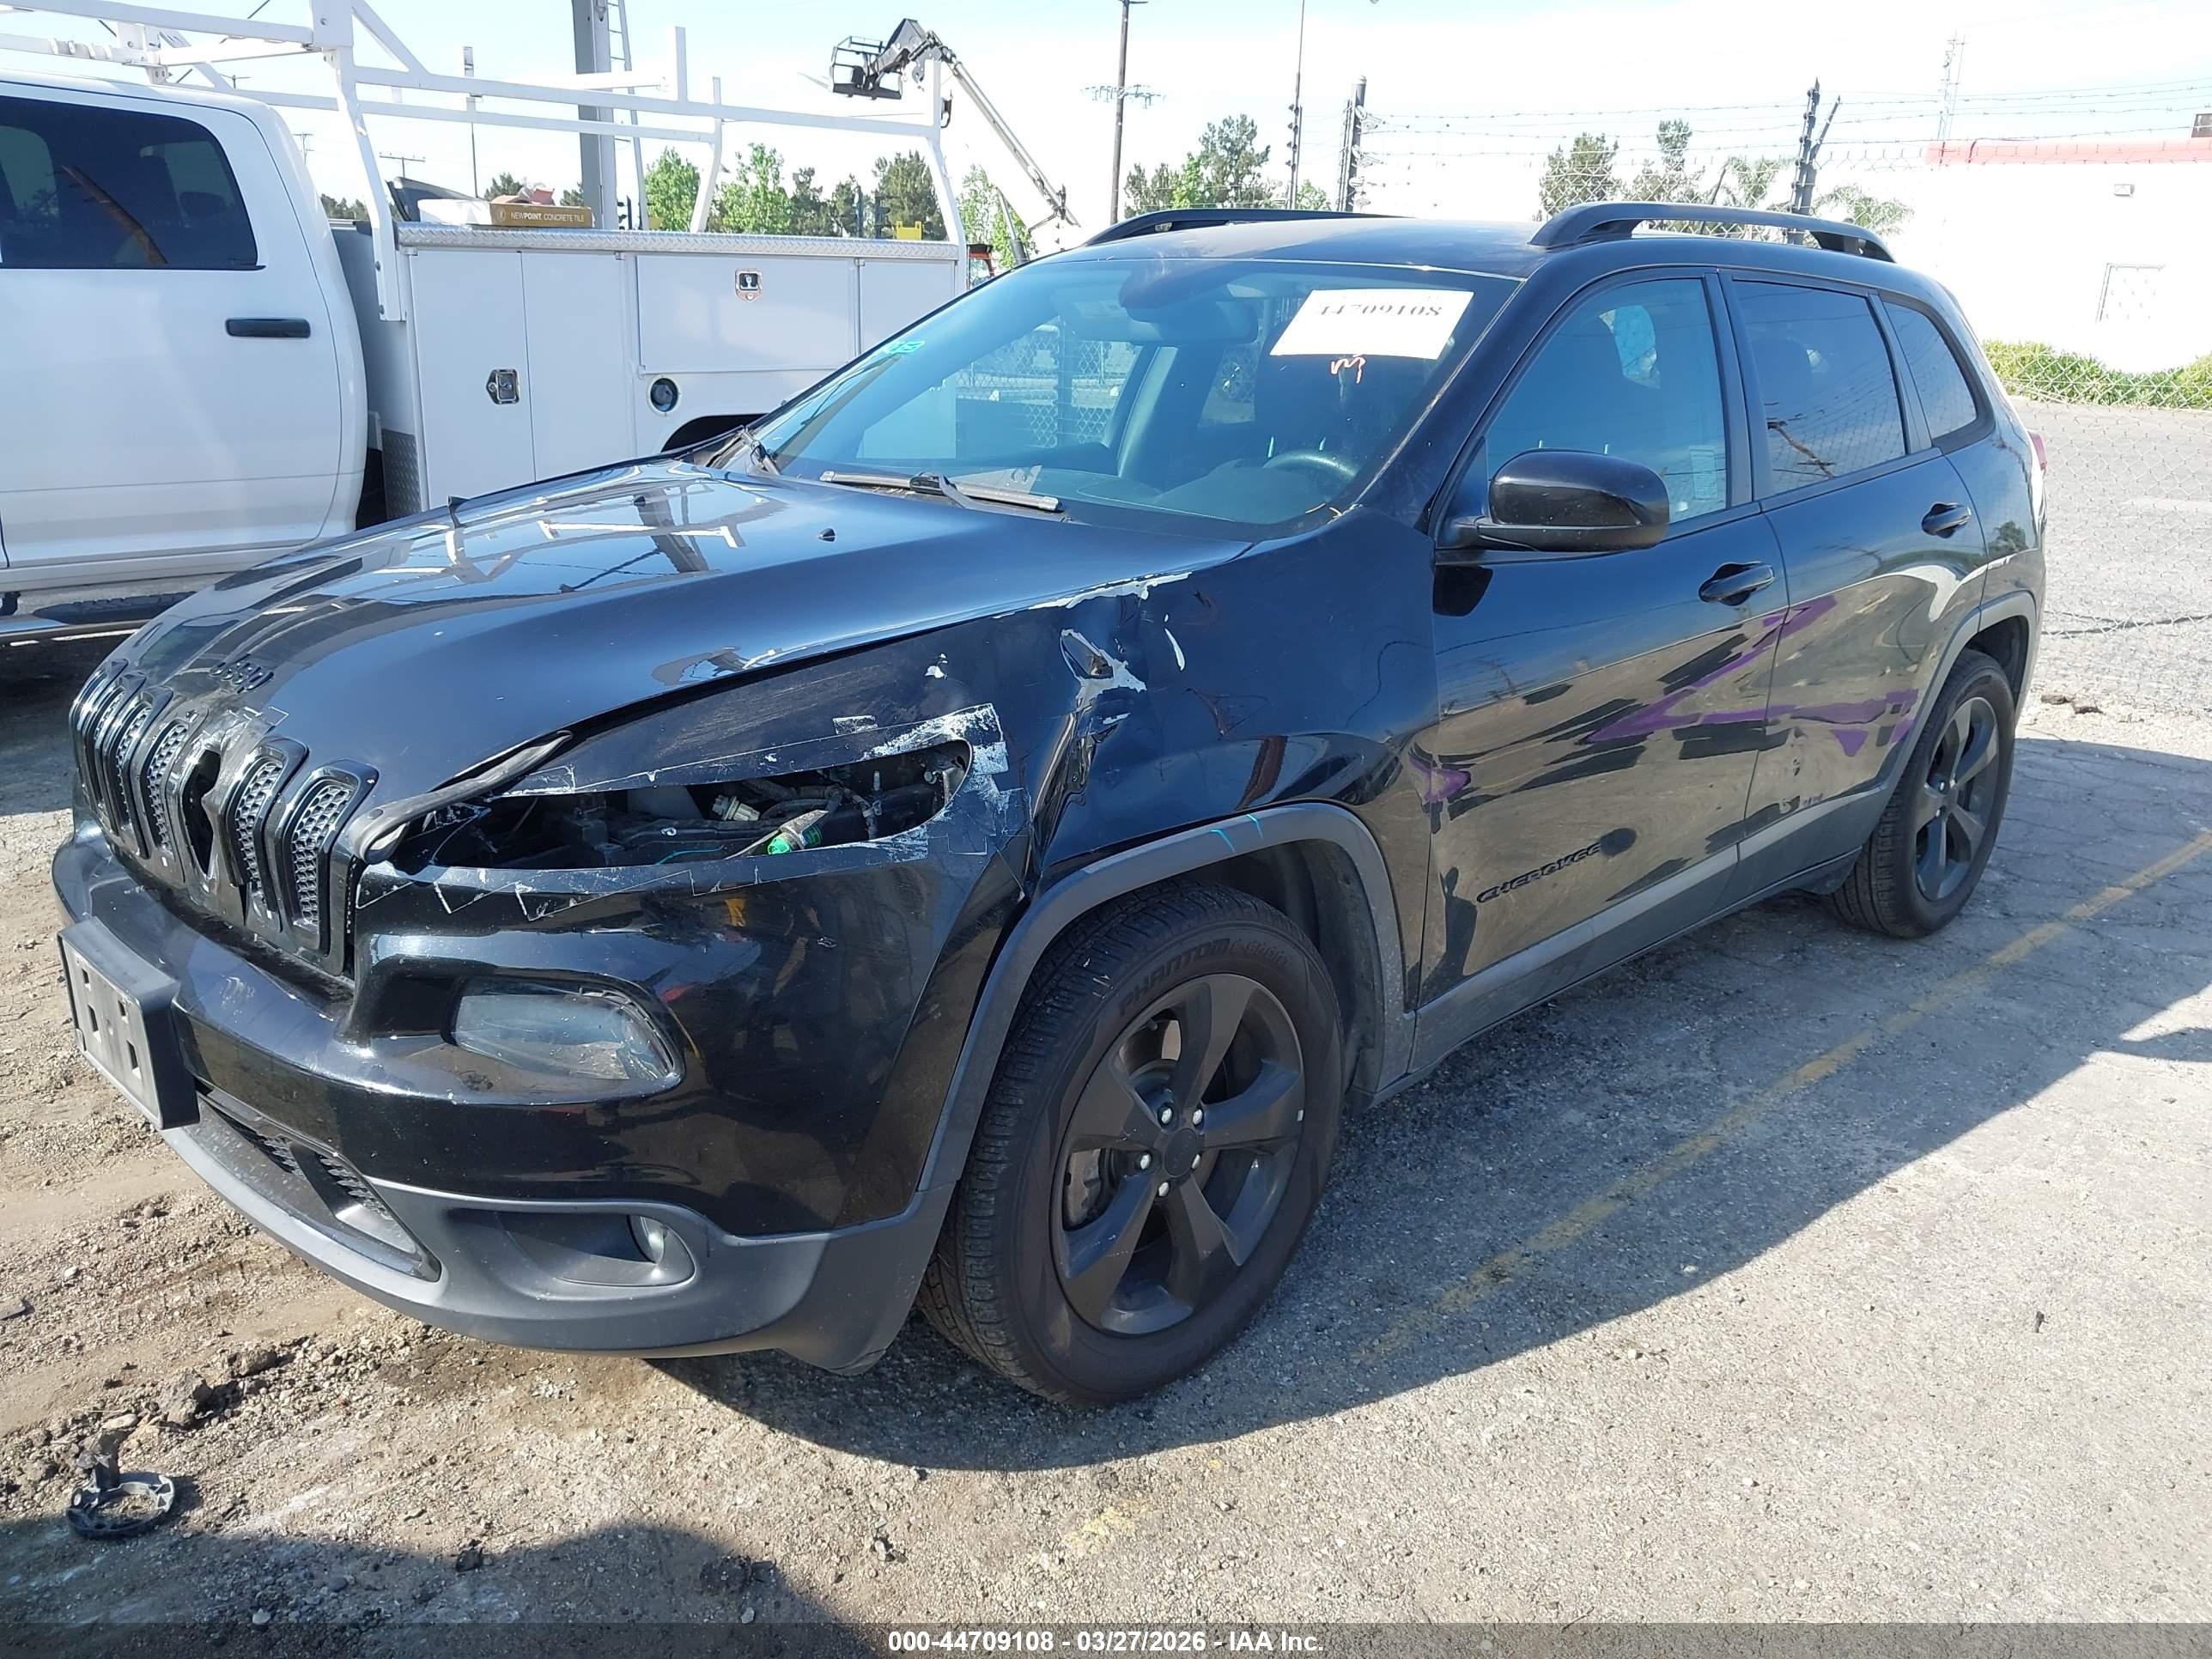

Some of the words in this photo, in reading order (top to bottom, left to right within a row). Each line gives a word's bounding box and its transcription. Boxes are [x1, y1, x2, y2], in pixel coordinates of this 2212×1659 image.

[543, 213, 574, 222] CONCRETE
[574, 214, 585, 222] TILE
[1475, 842, 1601, 904] CHEROKEE
[1117, 938, 1231, 1017] PHANTOM
